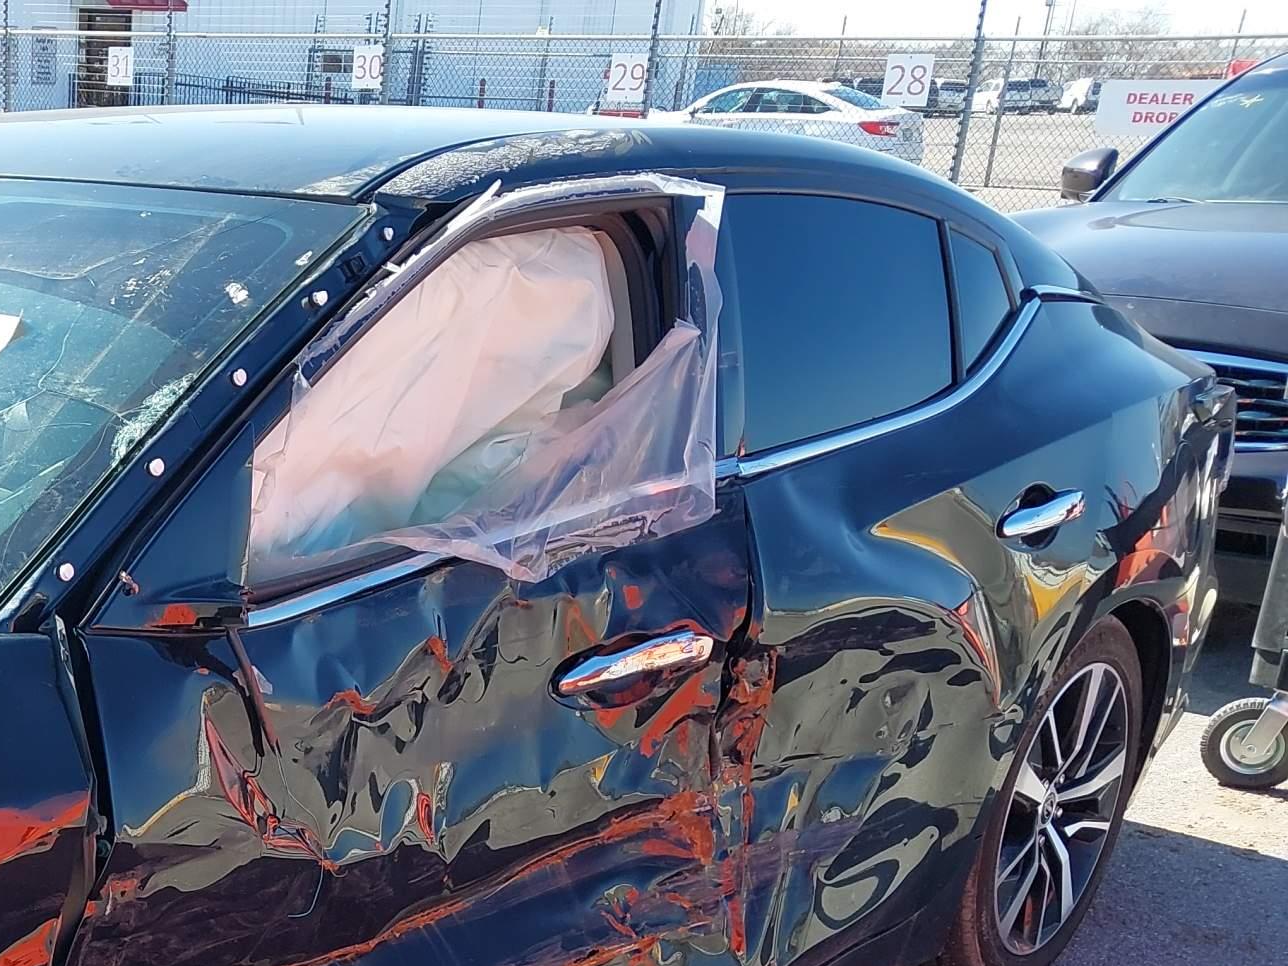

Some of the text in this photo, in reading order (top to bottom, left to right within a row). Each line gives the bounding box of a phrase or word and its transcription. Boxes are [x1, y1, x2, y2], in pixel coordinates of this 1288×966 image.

[110, 54, 131, 78] 31
[355, 54, 382, 79] 30
[611, 63, 646, 91] 29
[886, 64, 928, 96] 28
[1126, 92, 1195, 105] DEALER
